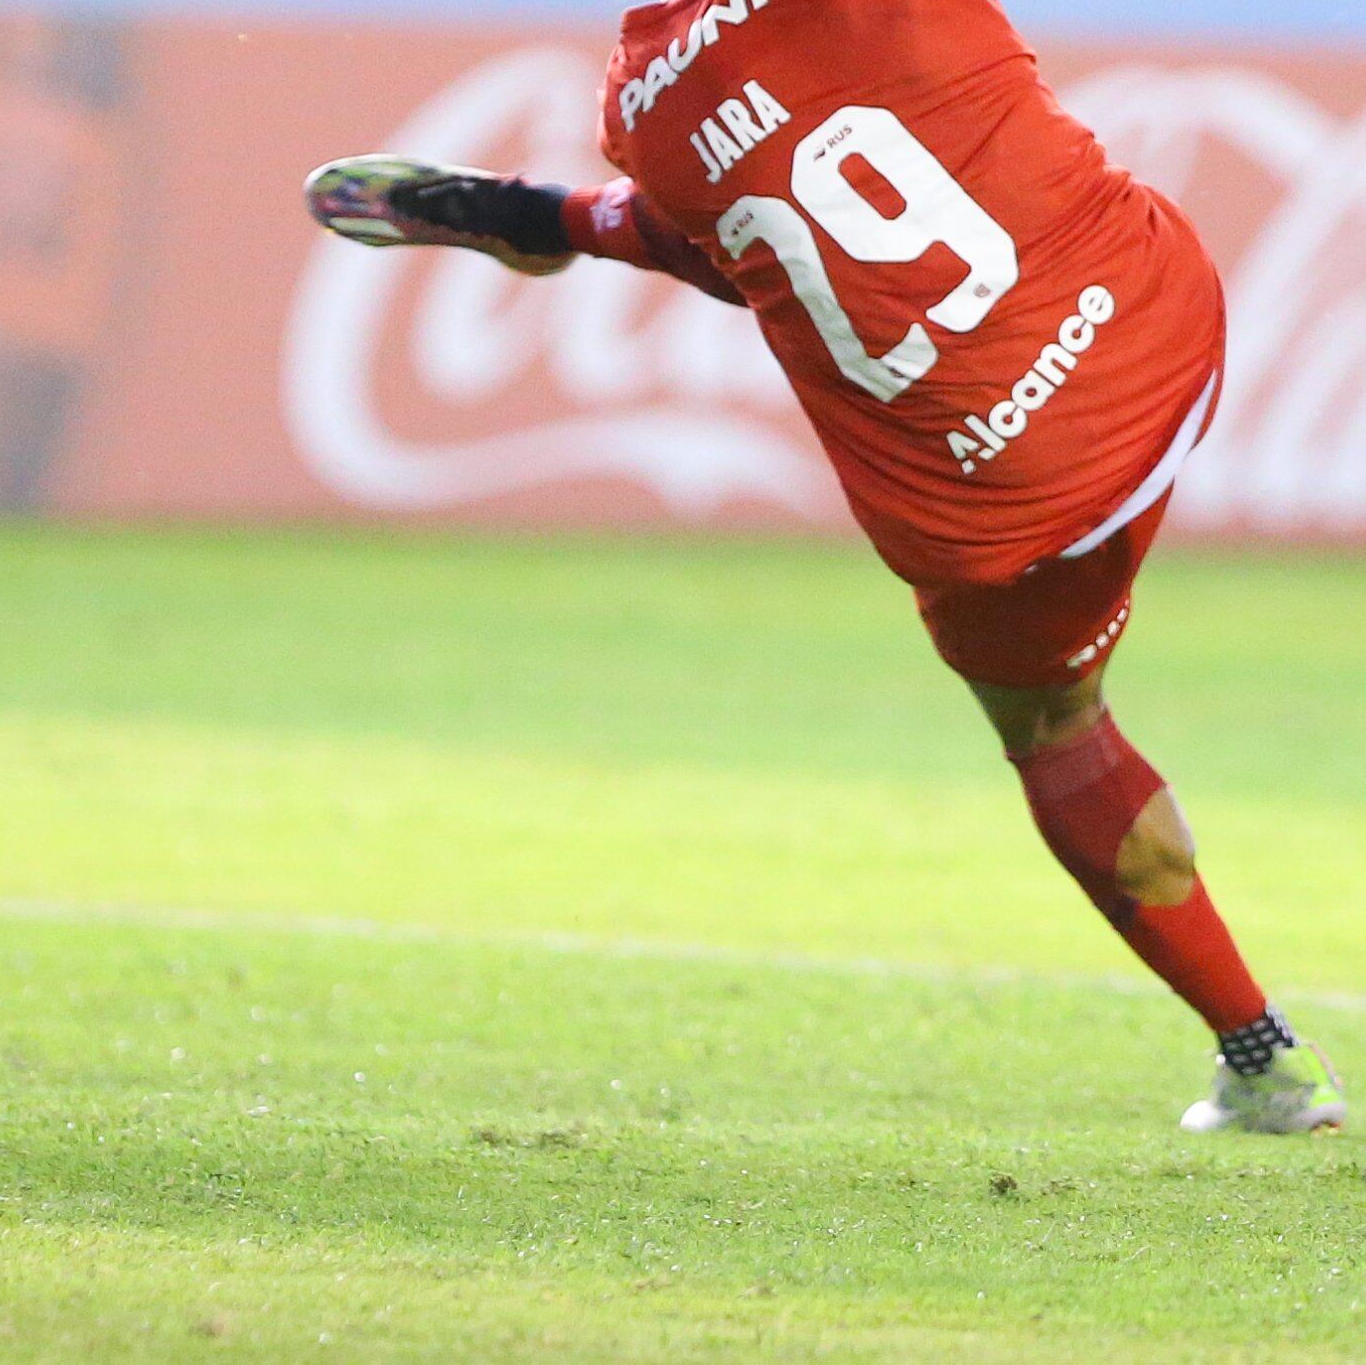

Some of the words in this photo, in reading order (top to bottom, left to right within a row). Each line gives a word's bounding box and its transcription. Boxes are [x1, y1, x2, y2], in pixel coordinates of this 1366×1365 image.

[689, 79, 792, 184] JARA
[826, 123, 853, 150] RUS
[716, 105, 1019, 403] 29
[946, 285, 1115, 475] Alcance
